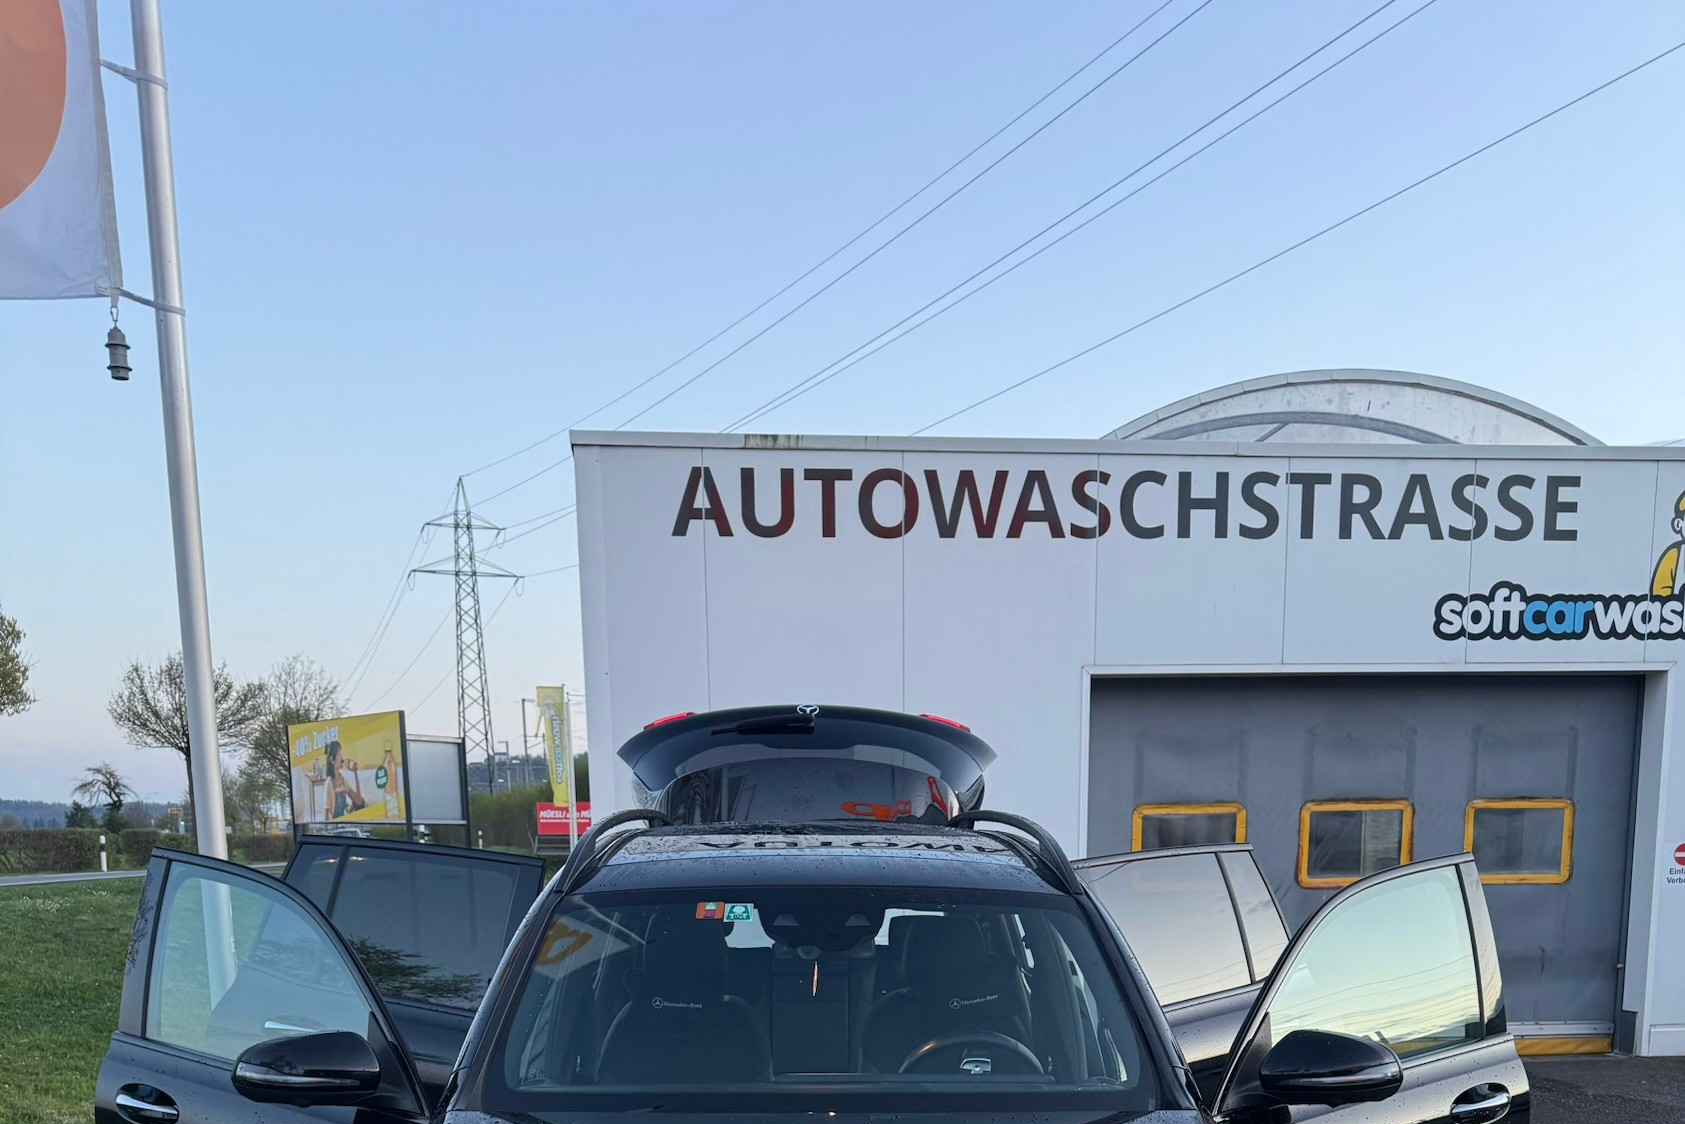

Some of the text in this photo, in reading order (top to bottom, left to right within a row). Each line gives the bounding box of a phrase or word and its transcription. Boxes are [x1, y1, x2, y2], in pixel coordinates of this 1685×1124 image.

[671, 466, 1581, 542] AUTOWASCHSTRASSE
[1437, 585, 1685, 636] softcarwas
[1669, 867, 1685, 875] Einf
